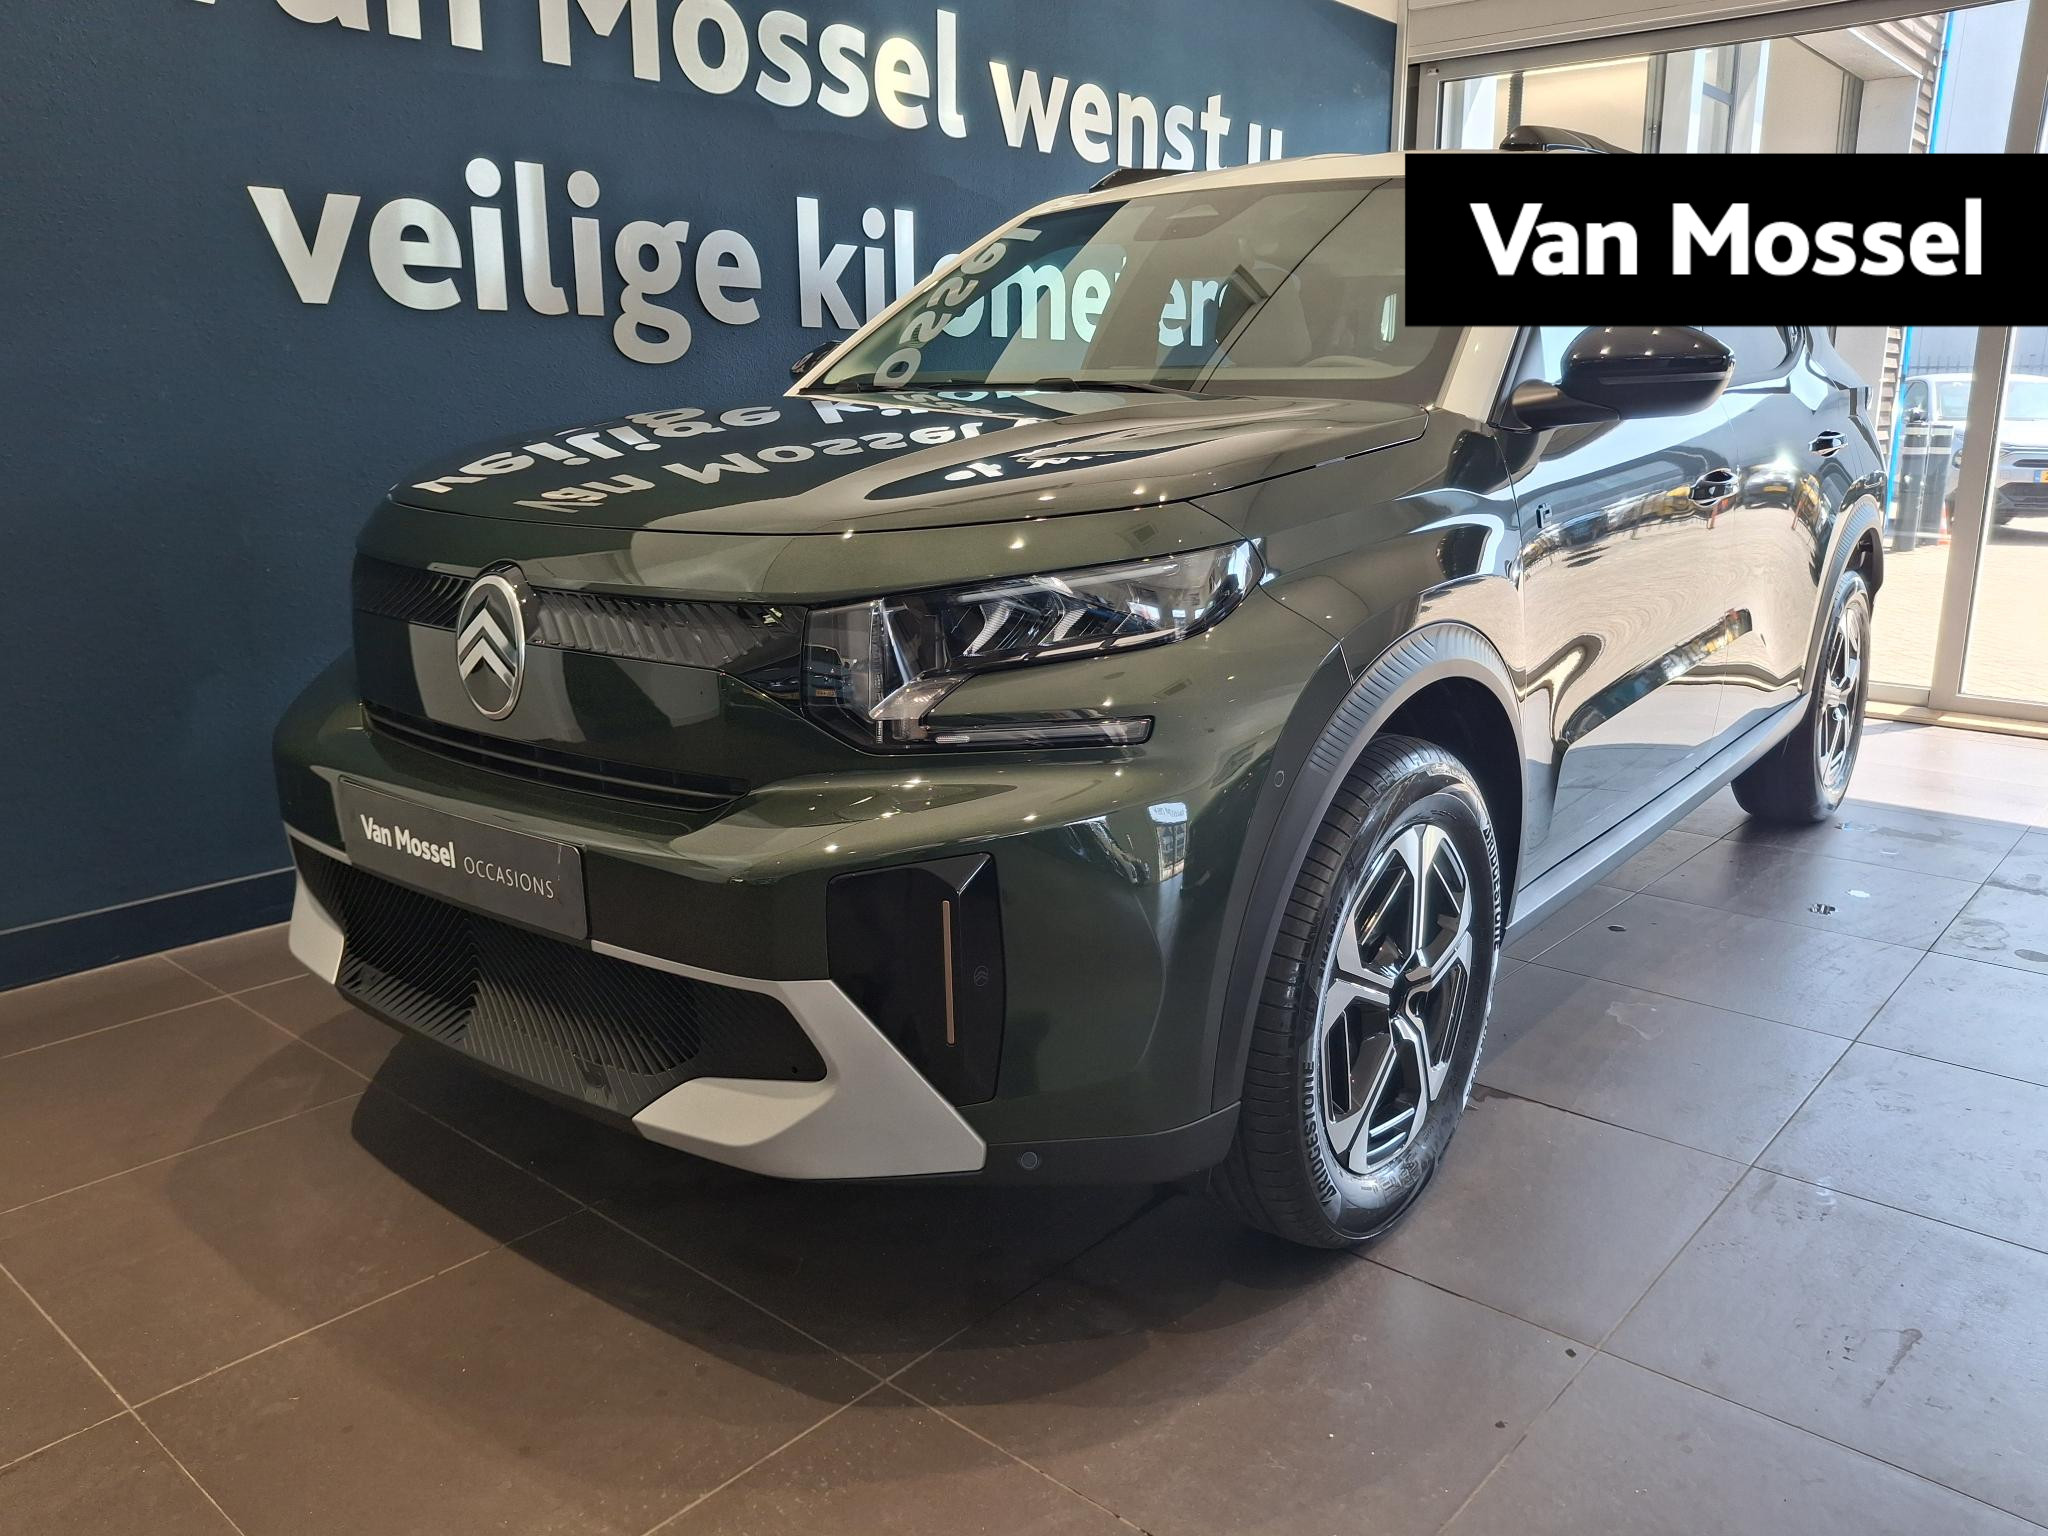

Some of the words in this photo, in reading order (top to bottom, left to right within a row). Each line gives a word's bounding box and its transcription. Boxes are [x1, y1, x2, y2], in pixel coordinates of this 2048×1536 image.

[989, 61, 1231, 171] wenst
[247, 157, 762, 364] veilige
[360, 814, 392, 848] Van
[394, 825, 456, 868] Mossel
[463, 856, 554, 899] OCCASIONS
[1304, 1061, 1337, 1206] BRIDGESTONE
